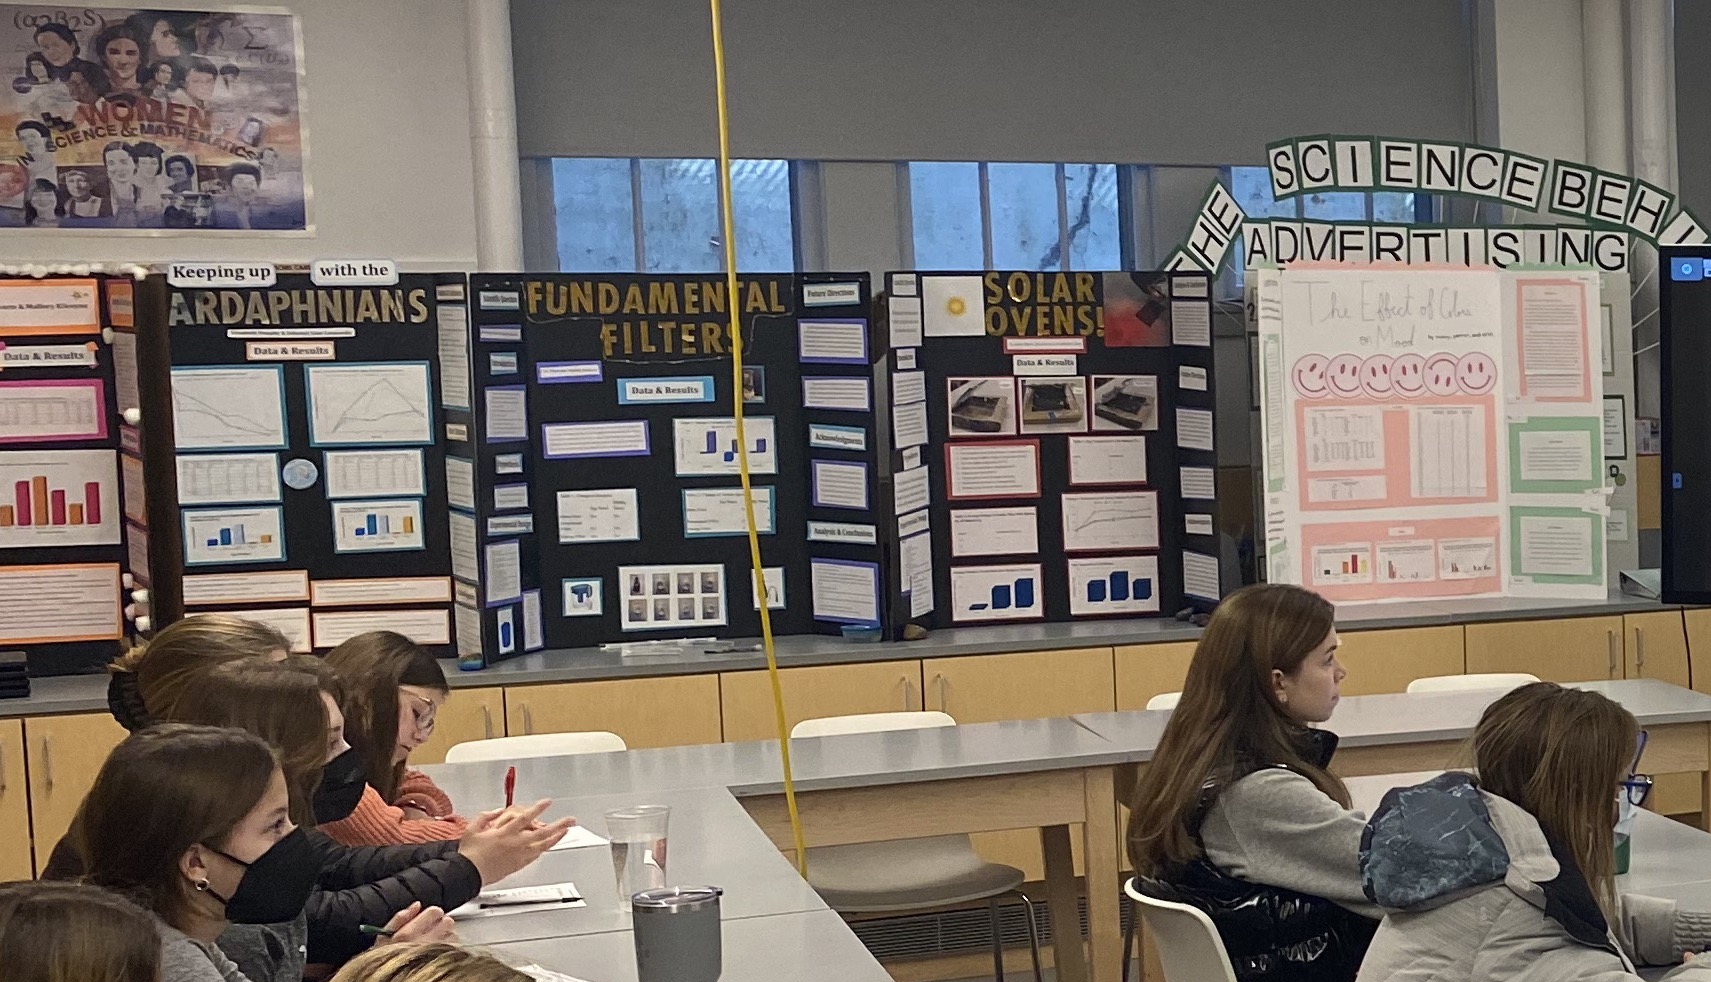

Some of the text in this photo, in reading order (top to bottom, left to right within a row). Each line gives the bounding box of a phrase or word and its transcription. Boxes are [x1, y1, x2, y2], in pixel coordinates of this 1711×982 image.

[76, 96, 210, 131] WOMEN
[1272, 143, 1539, 202] SCIENCE
[173, 265, 245, 280] Keeping
[249, 267, 271, 280] up
[319, 264, 357, 276] with
[361, 264, 389, 276] the
[984, 271, 1097, 305] SOLAR
[168, 288, 429, 326] ARDAPHNIANS
[1292, 279, 1352, 326] The
[1360, 279, 1414, 322] Effect
[1419, 287, 1434, 320] of
[985, 304, 1105, 337] OVENS!
[1359, 324, 1416, 348] on Mood
[32, 352, 41, 360] &
[44, 351, 85, 360] Results
[253, 345, 329, 356] Data & Results
[1016, 359, 1036, 367] Data
[1045, 358, 1075, 367] Results
[631, 384, 699, 395] Data & Results
